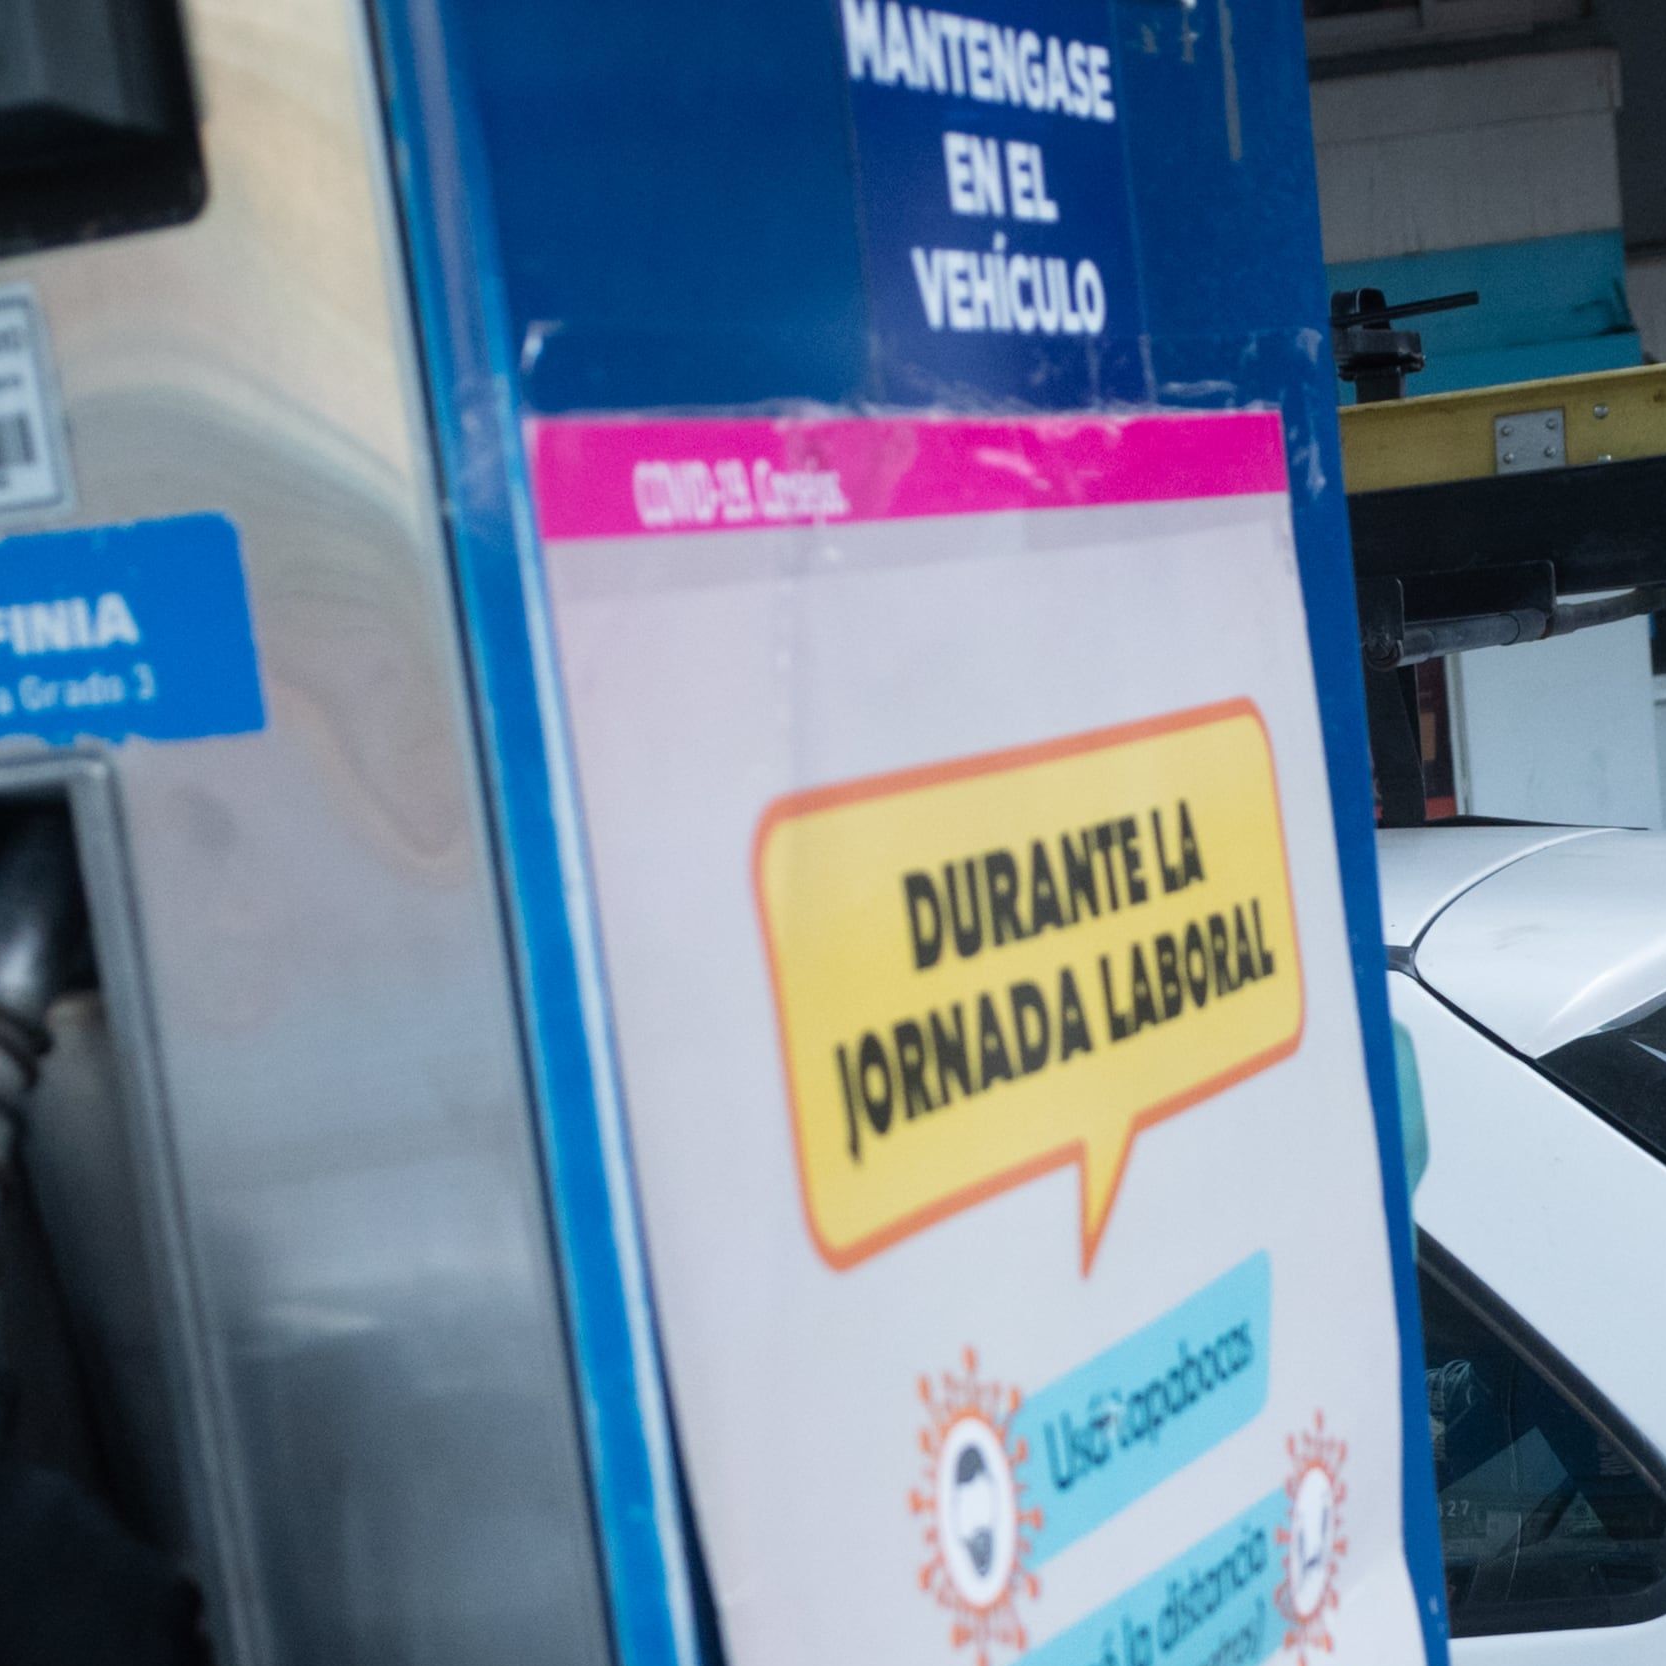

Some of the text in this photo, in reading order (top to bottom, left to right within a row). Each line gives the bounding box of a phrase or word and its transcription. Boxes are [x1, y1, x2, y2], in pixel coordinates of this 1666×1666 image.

[840, 0, 1116, 123] MANTENGASE
[943, 131, 1060, 223] EN EL
[910, 229, 1107, 336] VEHÍCULO
[17, 672, 126, 712] Grado
[133, 662, 156, 702] 3
[901, 798, 1206, 972] DURANTE LA
[836, 898, 1276, 1166] JORNADA LABORAL
[1438, 1499, 1470, 1518] 27
[1156, 1523, 1268, 1654] distancia
